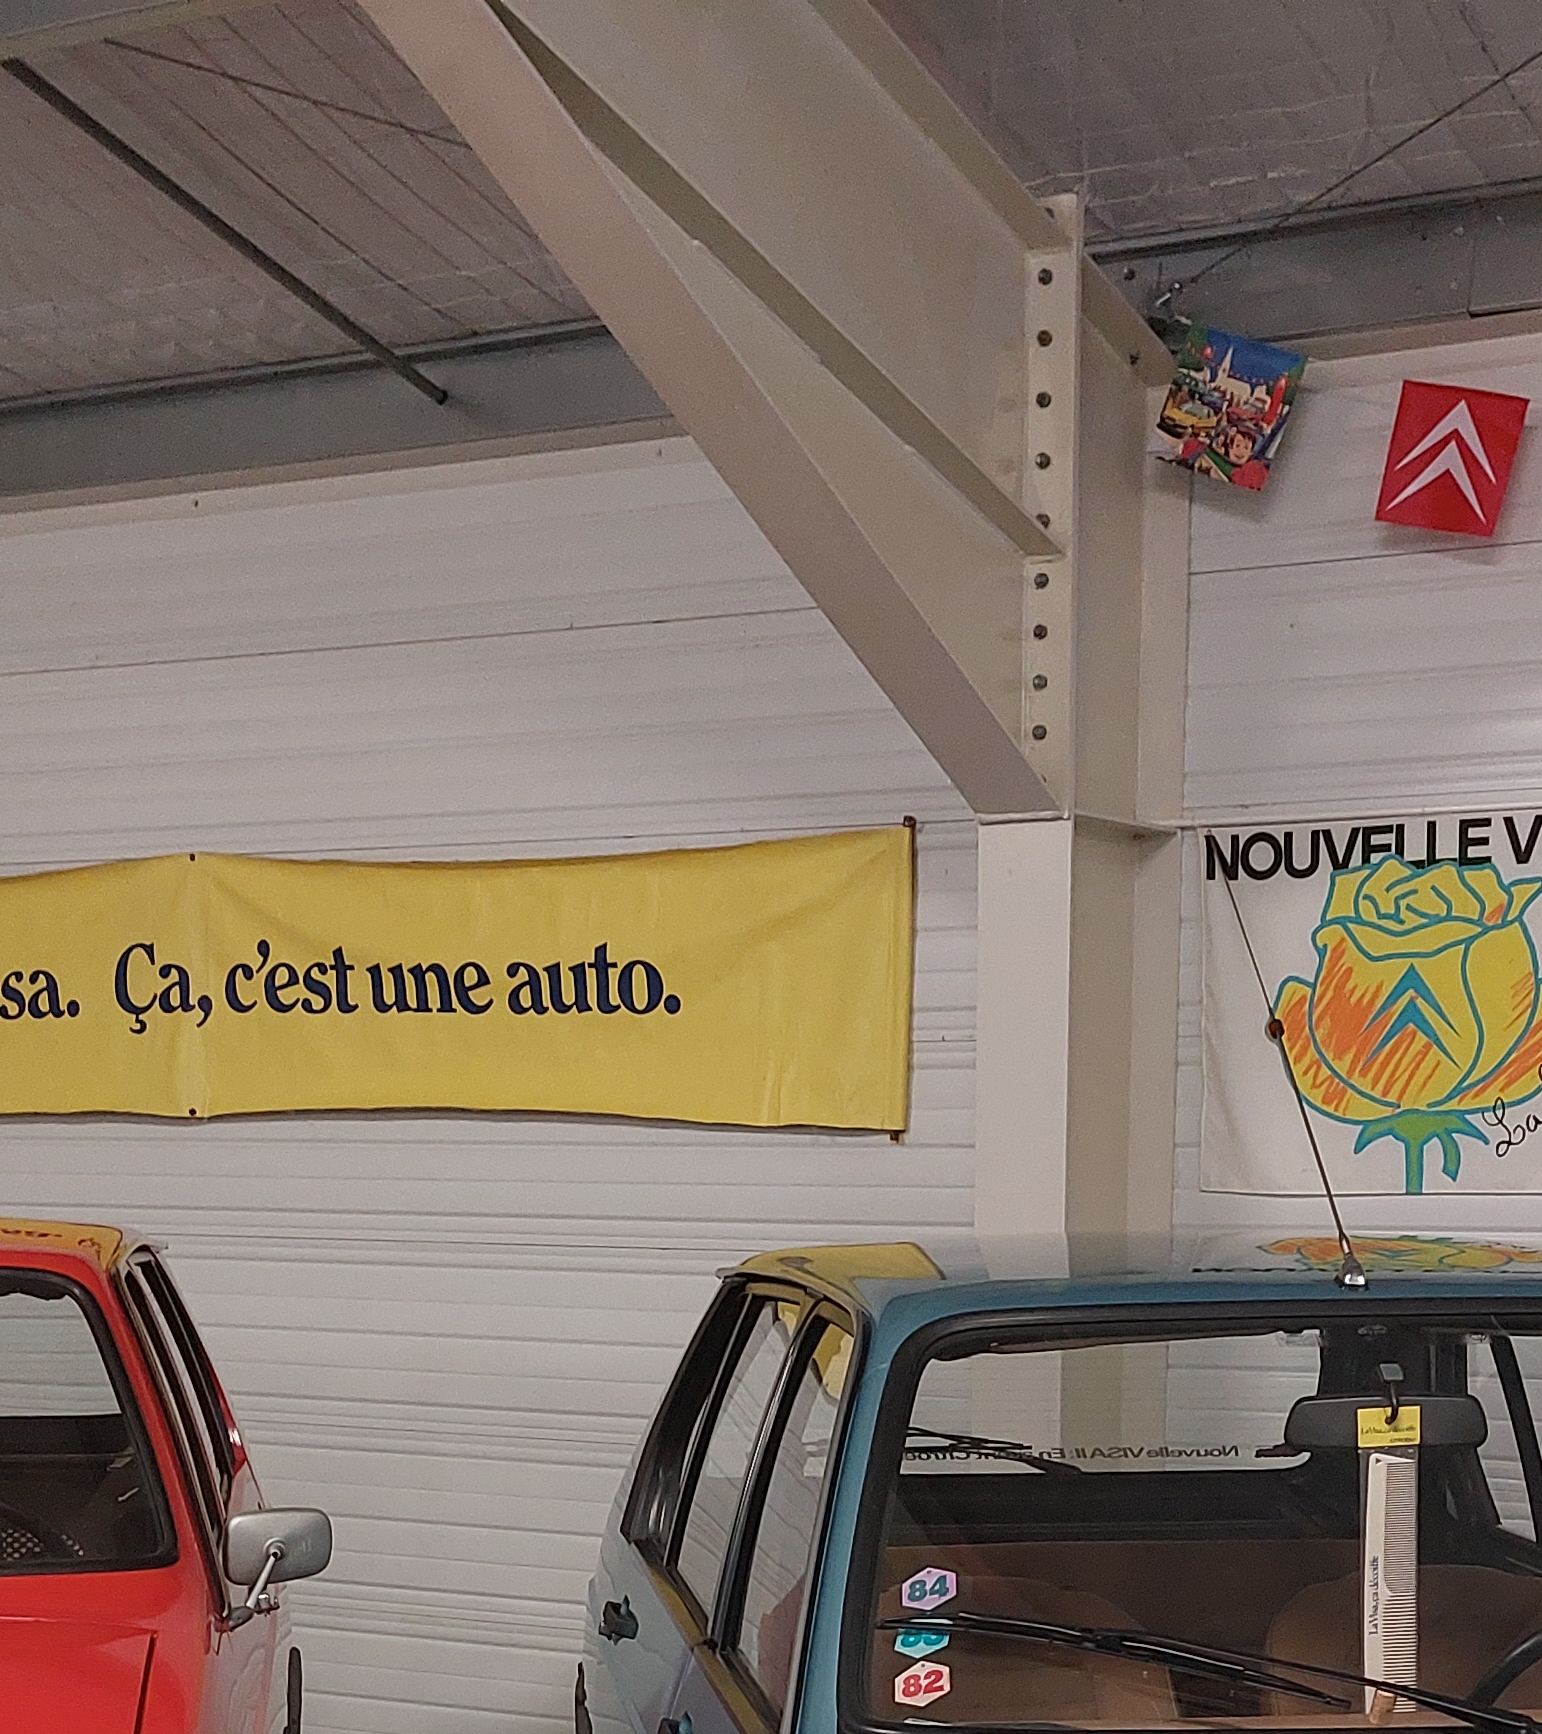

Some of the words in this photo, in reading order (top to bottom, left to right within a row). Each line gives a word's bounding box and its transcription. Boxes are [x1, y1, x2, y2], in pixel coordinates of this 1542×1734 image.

[1205, 817, 1492, 880] NOUVELLE
[114, 942, 213, 1034] Ça,
[224, 938, 360, 1015] c'est
[366, 959, 495, 1015] une
[506, 942, 682, 1015] auto.
[907, 1575, 949, 1603] 84
[901, 1669, 945, 1698] 82
